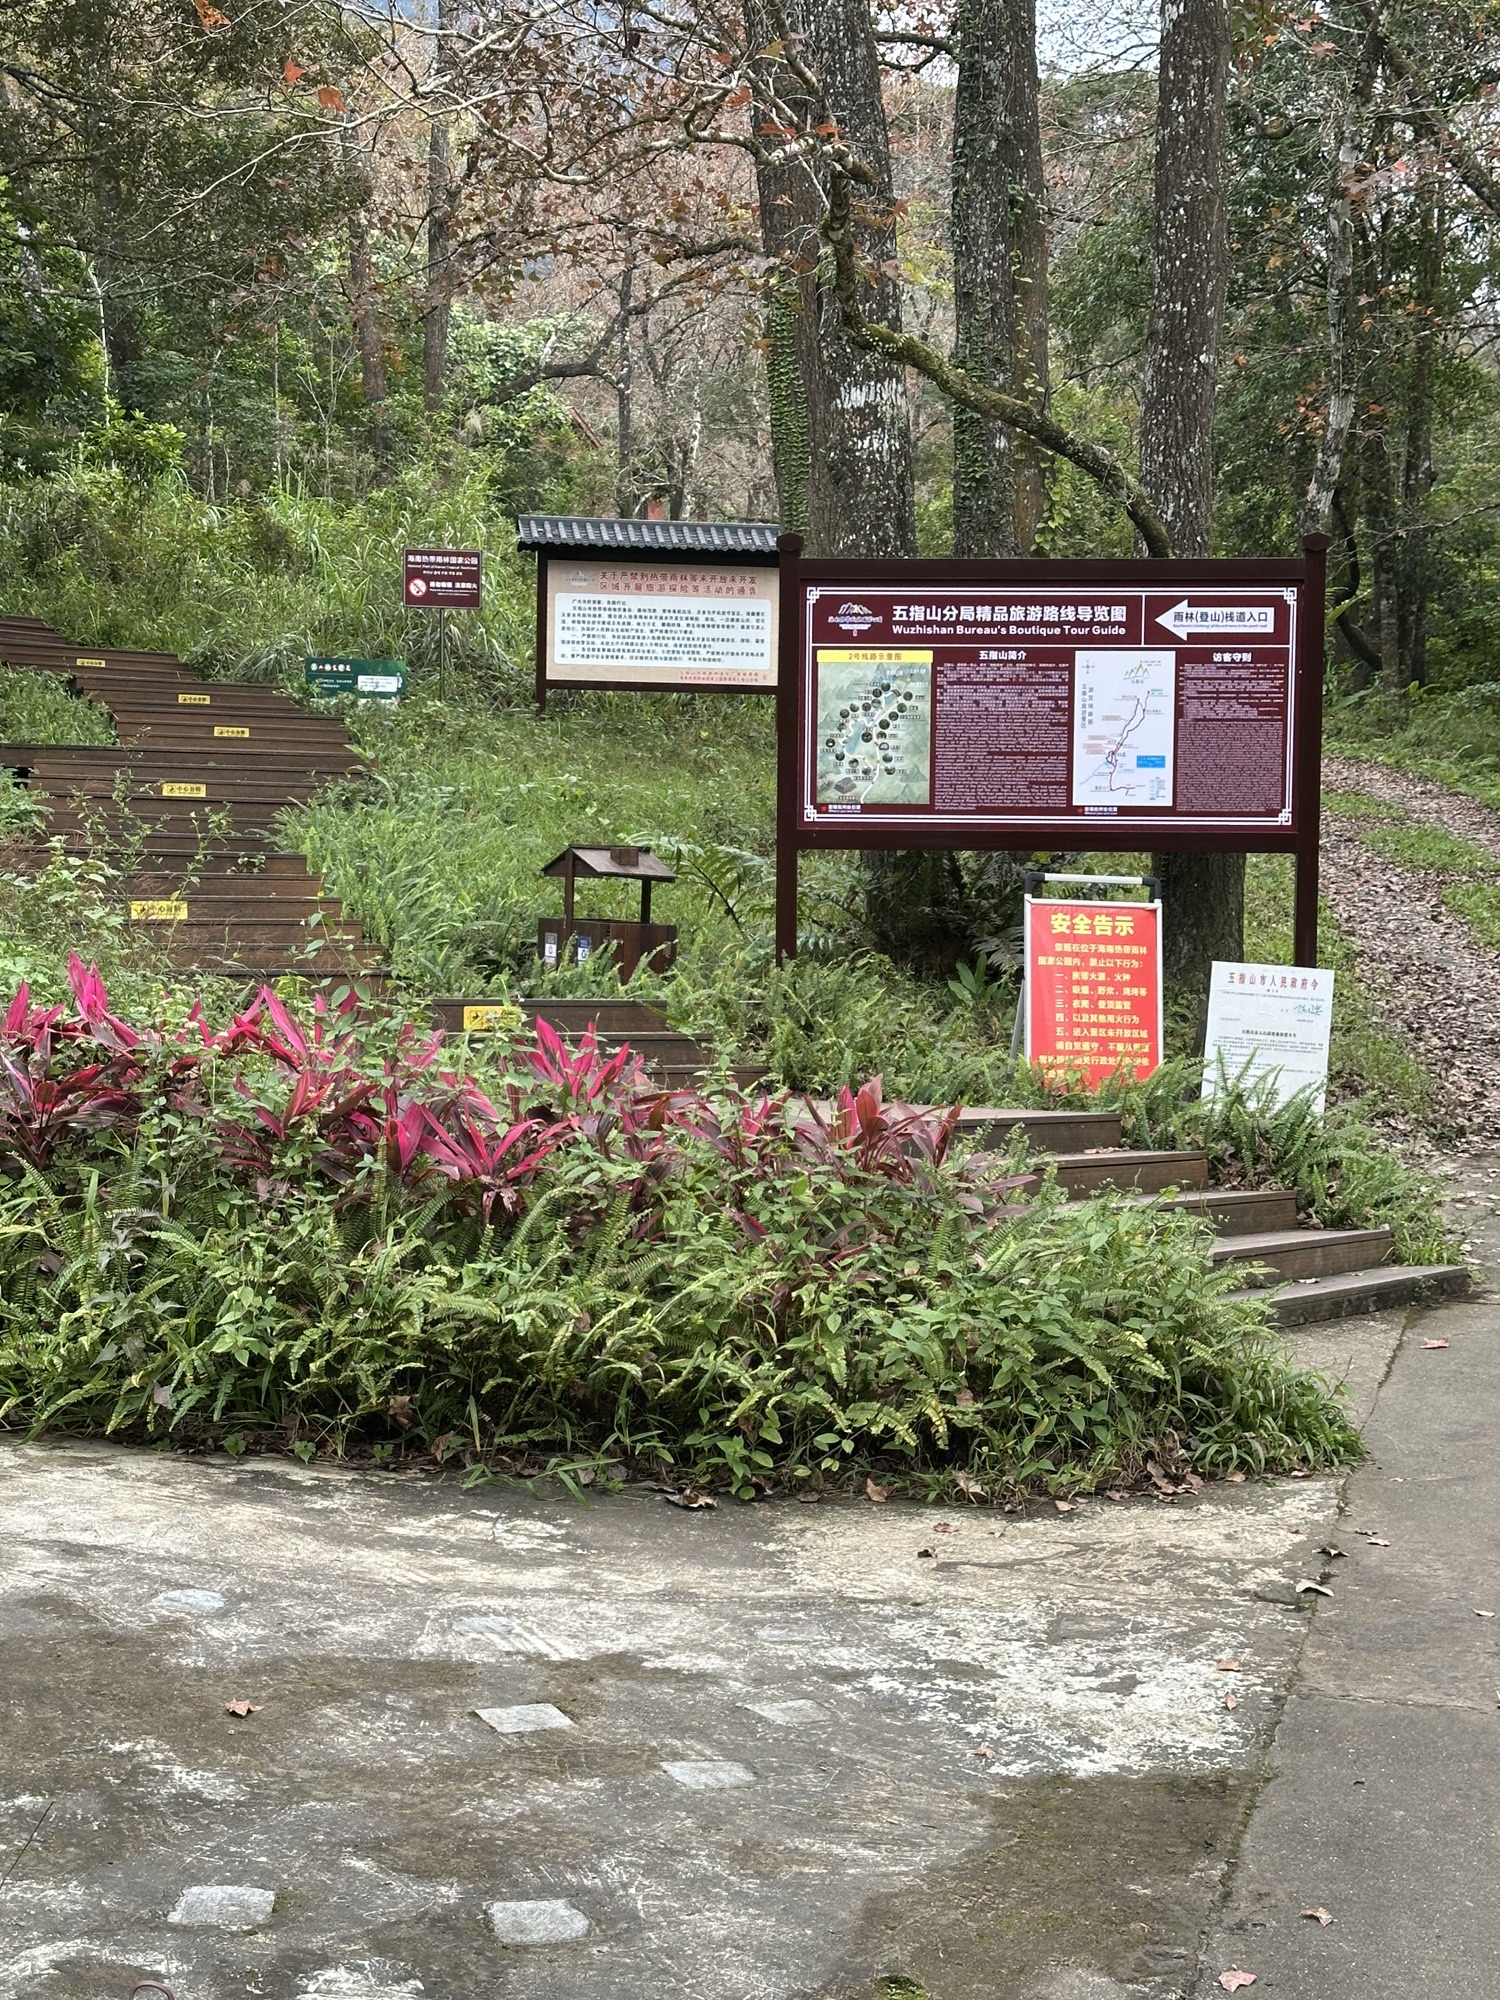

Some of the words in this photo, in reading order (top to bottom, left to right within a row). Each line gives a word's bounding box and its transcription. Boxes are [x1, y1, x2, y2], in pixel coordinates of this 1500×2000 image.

[599, 571, 758, 584] 关于严禁到热带雨林等未开放未开发
[599, 582, 757, 596] 区域开展旅游探险等活动的通告
[892, 605, 1127, 622] 五指山分局精品旅游路线导览图
[1173, 611, 1268, 623] 雨林(登山)栈道入口
[892, 625, 954, 634] Wuzhishan
[956, 624, 1006, 634] Bureau's
[1009, 624, 1061, 636] Boutique
[1063, 625, 1089, 634] Tour
[1092, 624, 1126, 634] Guide
[848, 652, 902, 661] 2号线路示意图
[979, 650, 1027, 660] 五指山简介
[1213, 652, 1252, 662] 访客守则
[1050, 913, 1135, 937] 安全告示
[1054, 942, 1148, 955] 您现在位于海南热带雨林
[1054, 971, 1131, 982] 一、携带火源、火种
[1228, 972, 1319, 990] 五指山市人民政府令
[1055, 984, 1148, 996] 二、吸烟、野炊、烧烤等
[1055, 1013, 1139, 1024] 四、以及其他用火行为
[1055, 1027, 1149, 1038] 五、进入景区未开放区域
